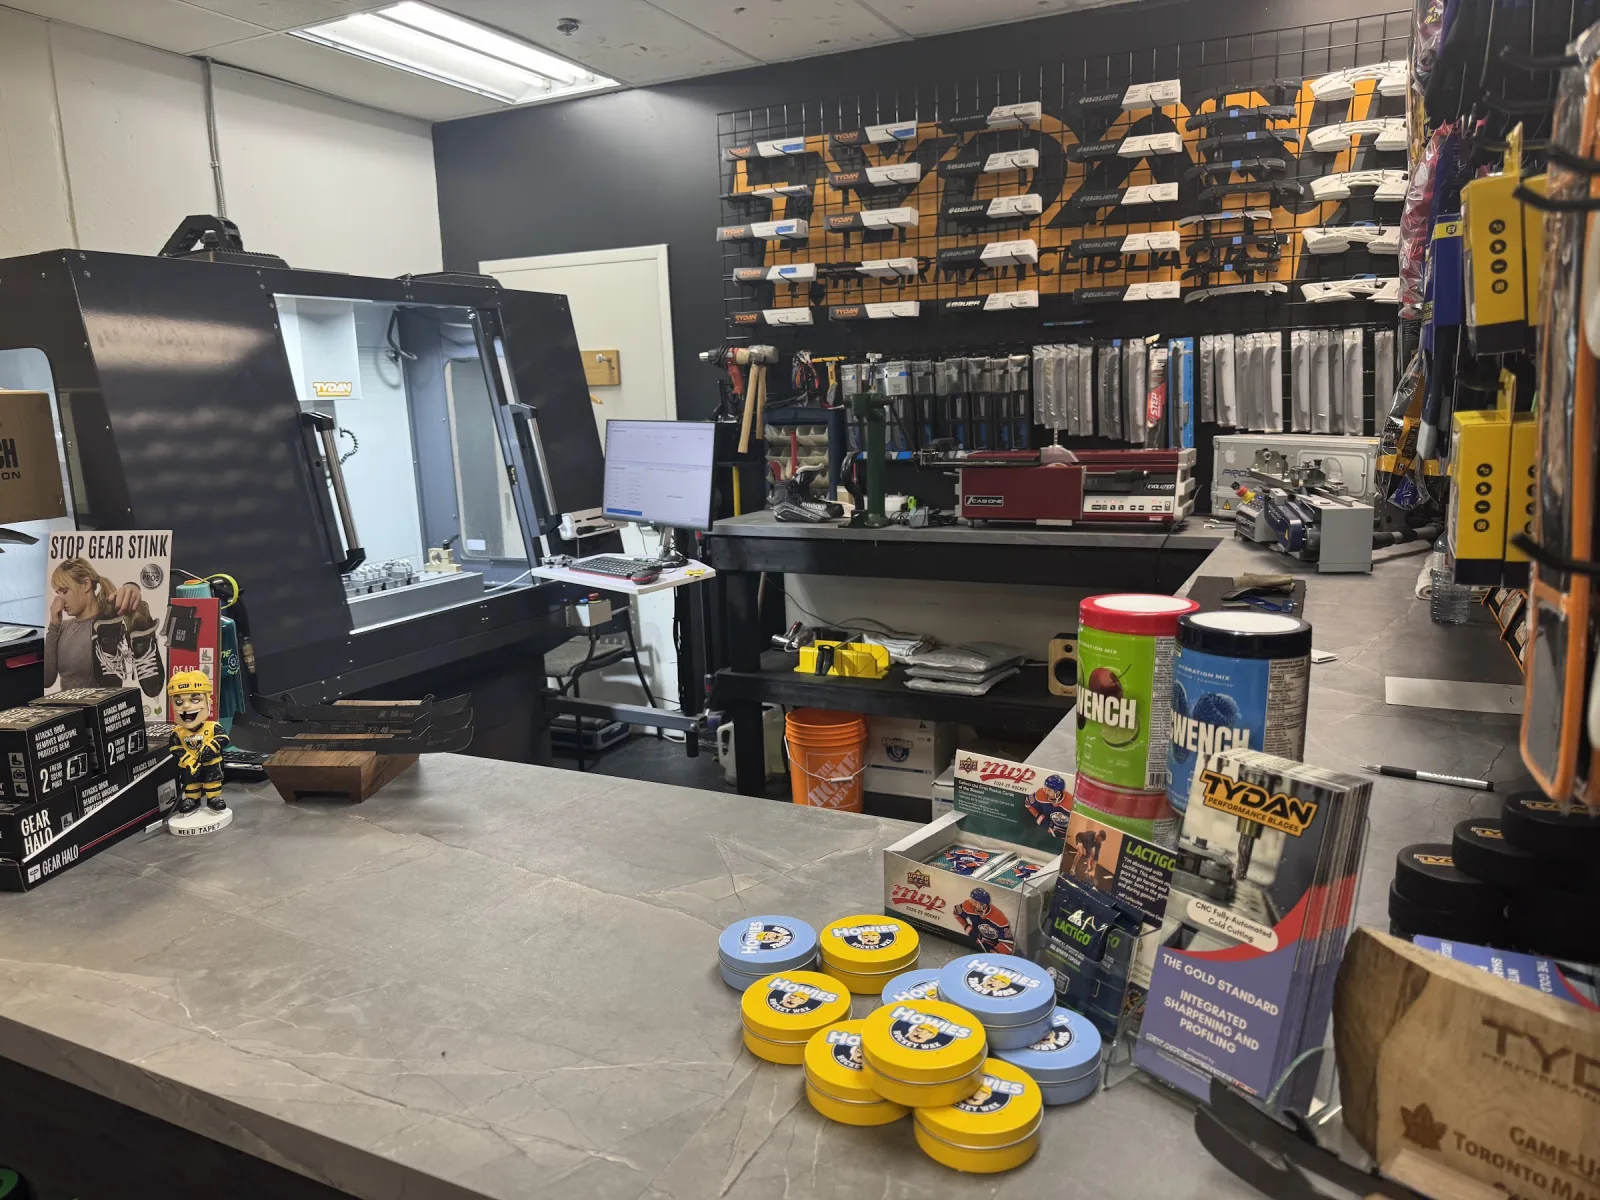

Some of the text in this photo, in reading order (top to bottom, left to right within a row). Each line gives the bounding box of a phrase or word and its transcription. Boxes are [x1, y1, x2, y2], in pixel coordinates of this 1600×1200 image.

[1085, 93, 1119, 103] BAUER
[835, 131, 858, 140] TYDAN
[1082, 143, 1116, 152] BAUER
[951, 161, 981, 169] BAUER
[835, 173, 859, 181] TYDAN
[1084, 193, 1119, 202] BAUER
[953, 205, 984, 213] BAUER
[829, 216, 854, 224] TYDAN
[1084, 241, 1118, 249] BAUER
[735, 313, 757, 322] TYDAN
[312, 381, 352, 393] TYDAN
[1150, 392, 1160, 416] STEP
[50, 534, 168, 560] STOP GEAR STINK
[1178, 664, 1214, 679] HYDRATION
[1215, 673, 1231, 681] MIX
[35, 728, 54, 741] ATTACKS
[36, 736, 57, 750] REMOVES
[37, 746, 59, 760] PROTECTS
[107, 742, 116, 766] 2
[40, 768, 51, 794] 2
[51, 779, 63, 790] PODS
[809, 752, 856, 807] HOME
[993, 780, 1028, 793] 2024-25 HOCKEY
[1002, 790, 1015, 798] Cards
[1204, 773, 1313, 825] TYDAN
[21, 809, 50, 837] GEAR
[1208, 797, 1299, 832] PERFORMANCE BLADES
[178, 823, 220, 836] NEED TAPE?
[23, 827, 53, 856] HALO
[42, 845, 79, 875] GEAR HALO
[1125, 841, 1176, 872] LACTIGO
[908, 872, 929, 880] UPPER
[1132, 860, 1152, 872] obsessed
[1153, 869, 1163, 877] with
[1139, 870, 1148, 878] This
[1120, 870, 1131, 879] guys
[1142, 879, 1157, 888] harder
[1158, 884, 1168, 892] and
[1134, 881, 1144, 889] both
[1126, 885, 1140, 896] during
[905, 905, 941, 921] 2024-25 HOCKEY
[1195, 901, 1273, 939] CNC Fully Automated
[740, 921, 764, 955] HOWIES
[832, 924, 899, 937] HOWIES
[1054, 917, 1091, 946] LACTIGO
[1208, 917, 1254, 943] Cold Cutting
[967, 959, 1040, 988] HOWIES
[1536, 960, 1552, 992] THE GOLD
[768, 977, 839, 1002] HOWIES
[1162, 953, 1279, 1016] THE GOLD STANDARD
[769, 998, 811, 1014] HOCKEY WAX
[1180, 989, 1247, 1030] INTEGRATED
[891, 1006, 971, 1039] HOWIES
[1163, 996, 1259, 1051] SHARPENING AND
[893, 1030, 942, 1050] HOCKEY WAX
[1179, 1017, 1237, 1053] PROFILING
[836, 1054, 862, 1069] HOCKE
[981, 1101, 1000, 1112] WAX
[1453, 1130, 1548, 1189] TORONTO
[1509, 1126, 1600, 1178] GAME-U
